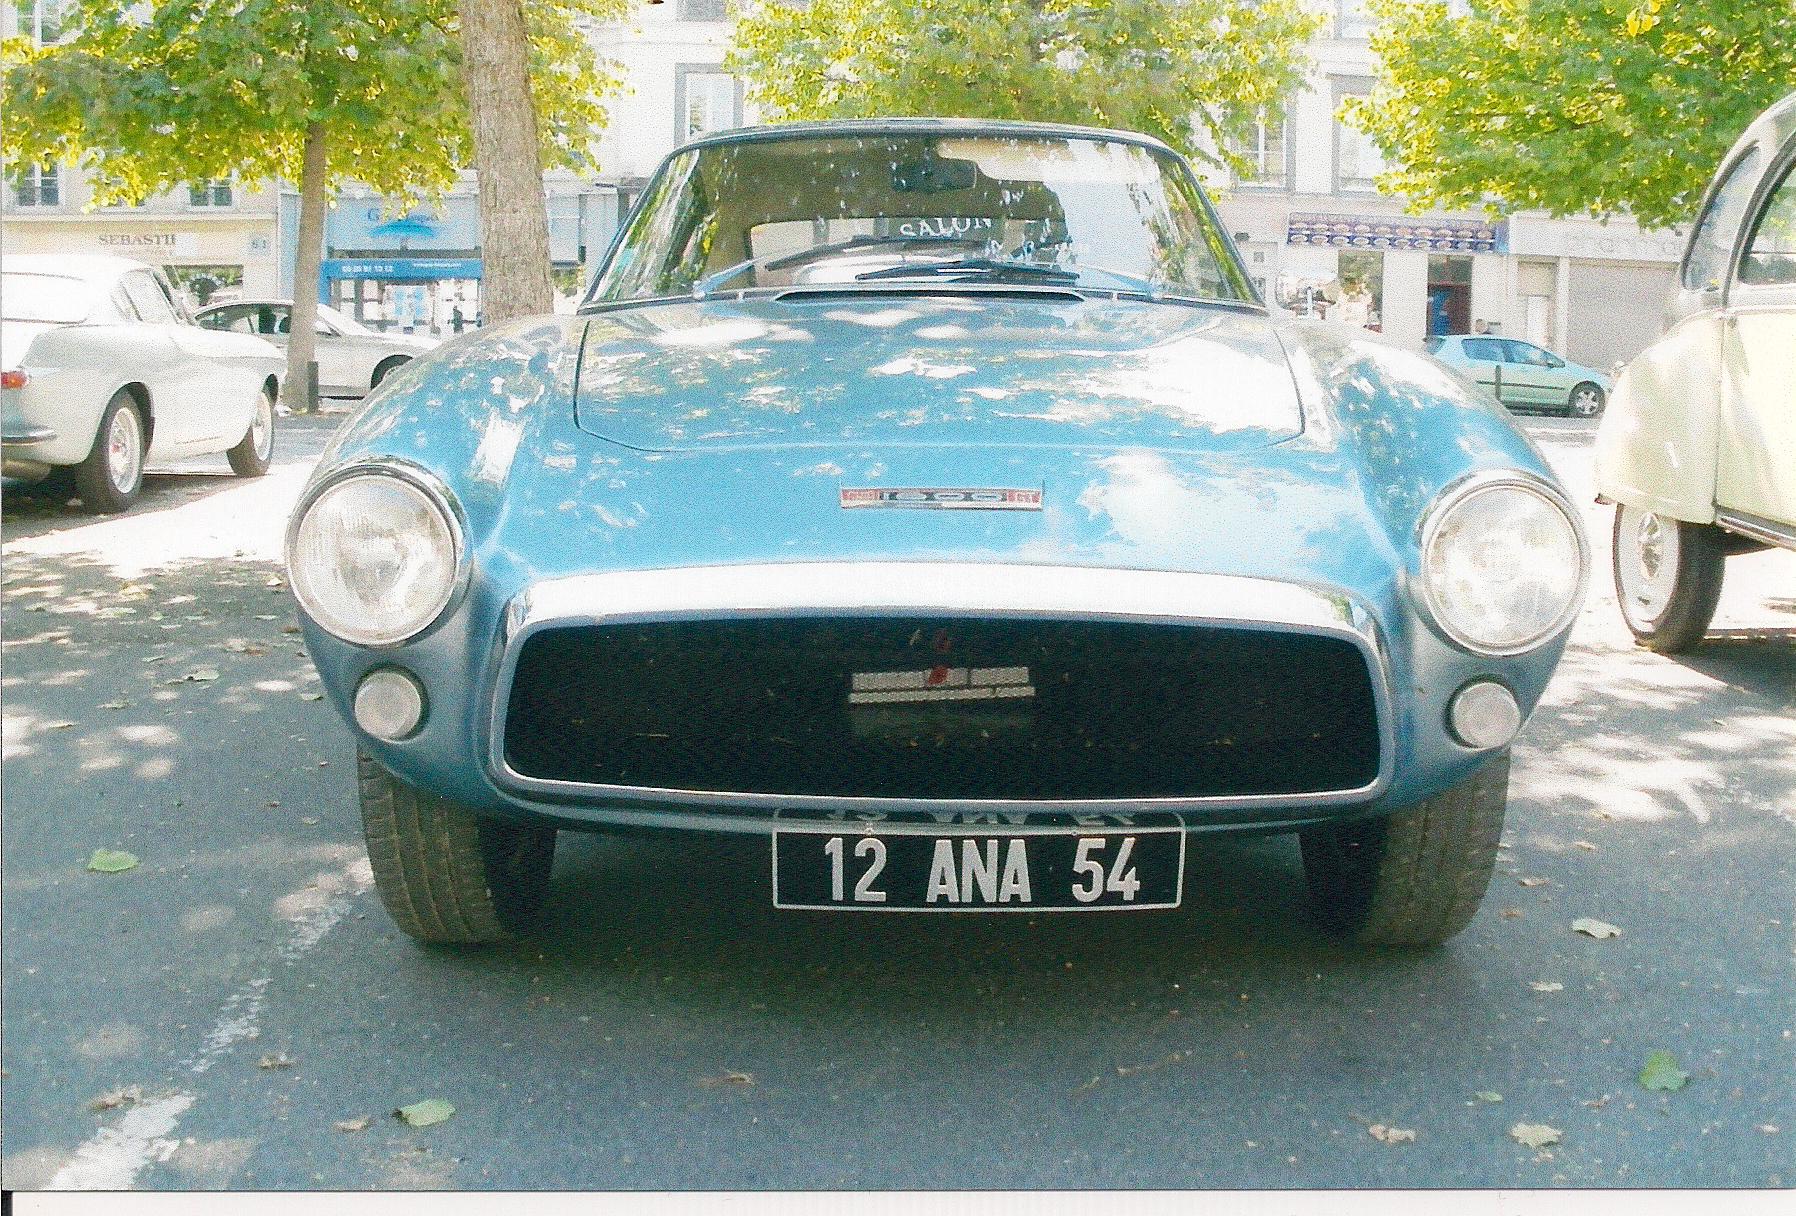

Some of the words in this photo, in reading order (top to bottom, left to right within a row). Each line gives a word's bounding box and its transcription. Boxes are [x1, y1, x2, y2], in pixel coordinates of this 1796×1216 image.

[824, 837, 888, 901] 12
[926, 839, 1032, 903] ANA
[1071, 837, 1141, 903] 54
